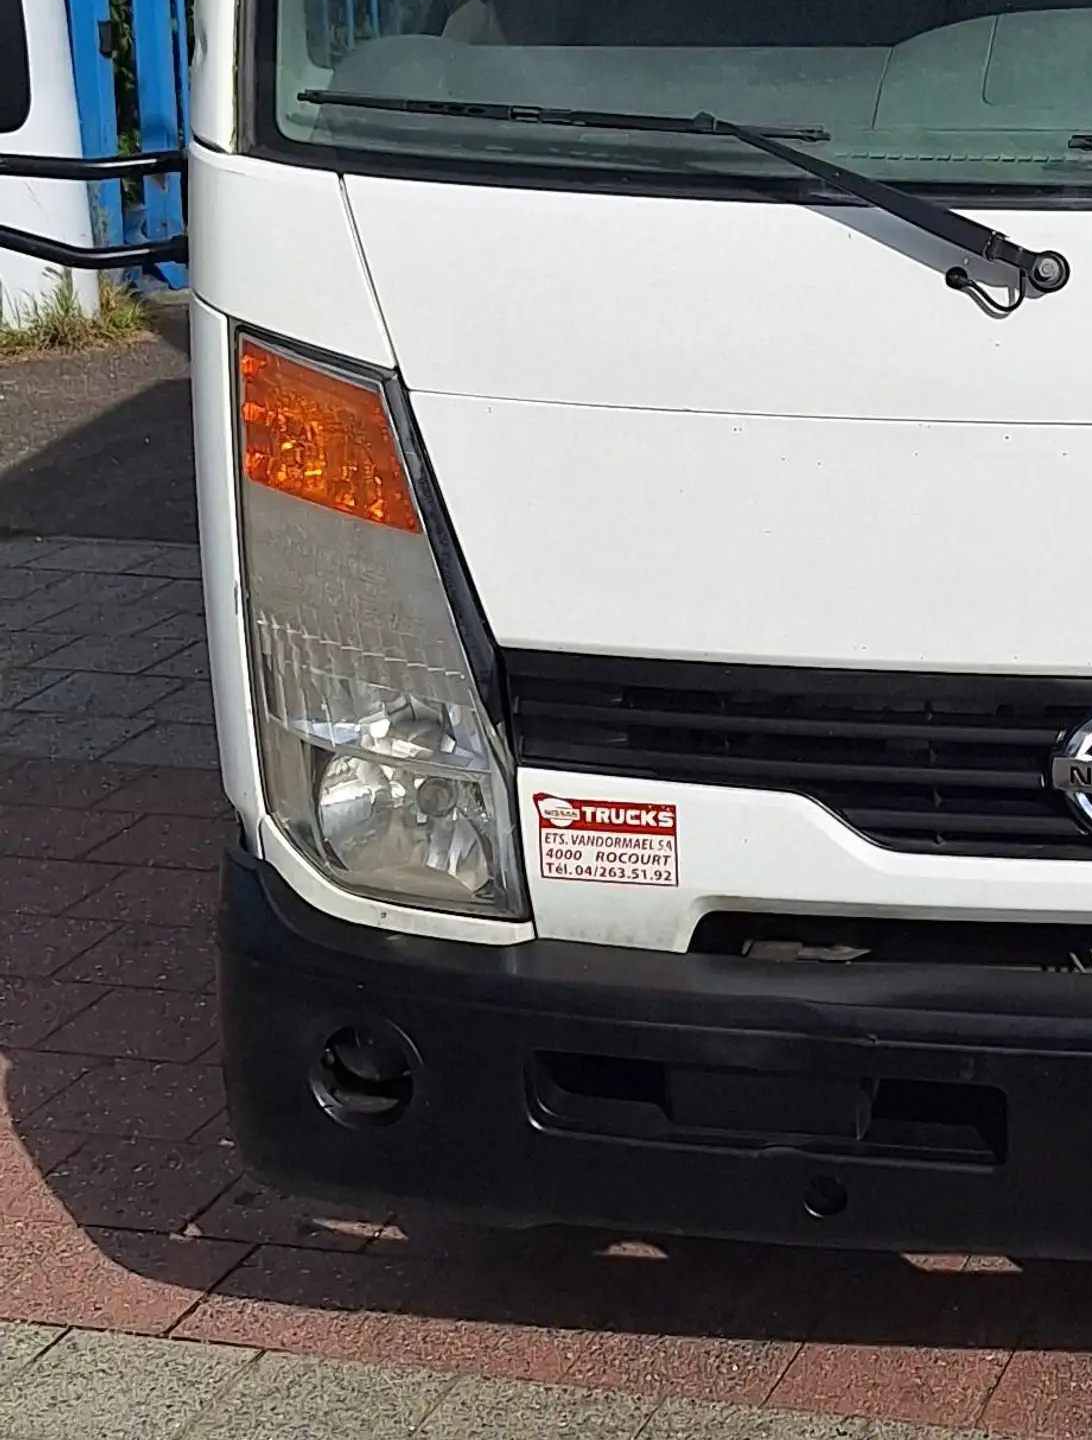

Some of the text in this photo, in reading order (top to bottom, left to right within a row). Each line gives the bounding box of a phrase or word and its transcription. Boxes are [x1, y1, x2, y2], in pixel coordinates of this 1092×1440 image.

[581, 806, 674, 828] TRUCKS
[544, 833, 569, 846] ETS.
[571, 834, 654, 850] VANDORMAEL
[546, 848, 671, 866] 4000 ROCOURT
[546, 862, 672, 881] Tél. 04/263.51.92
